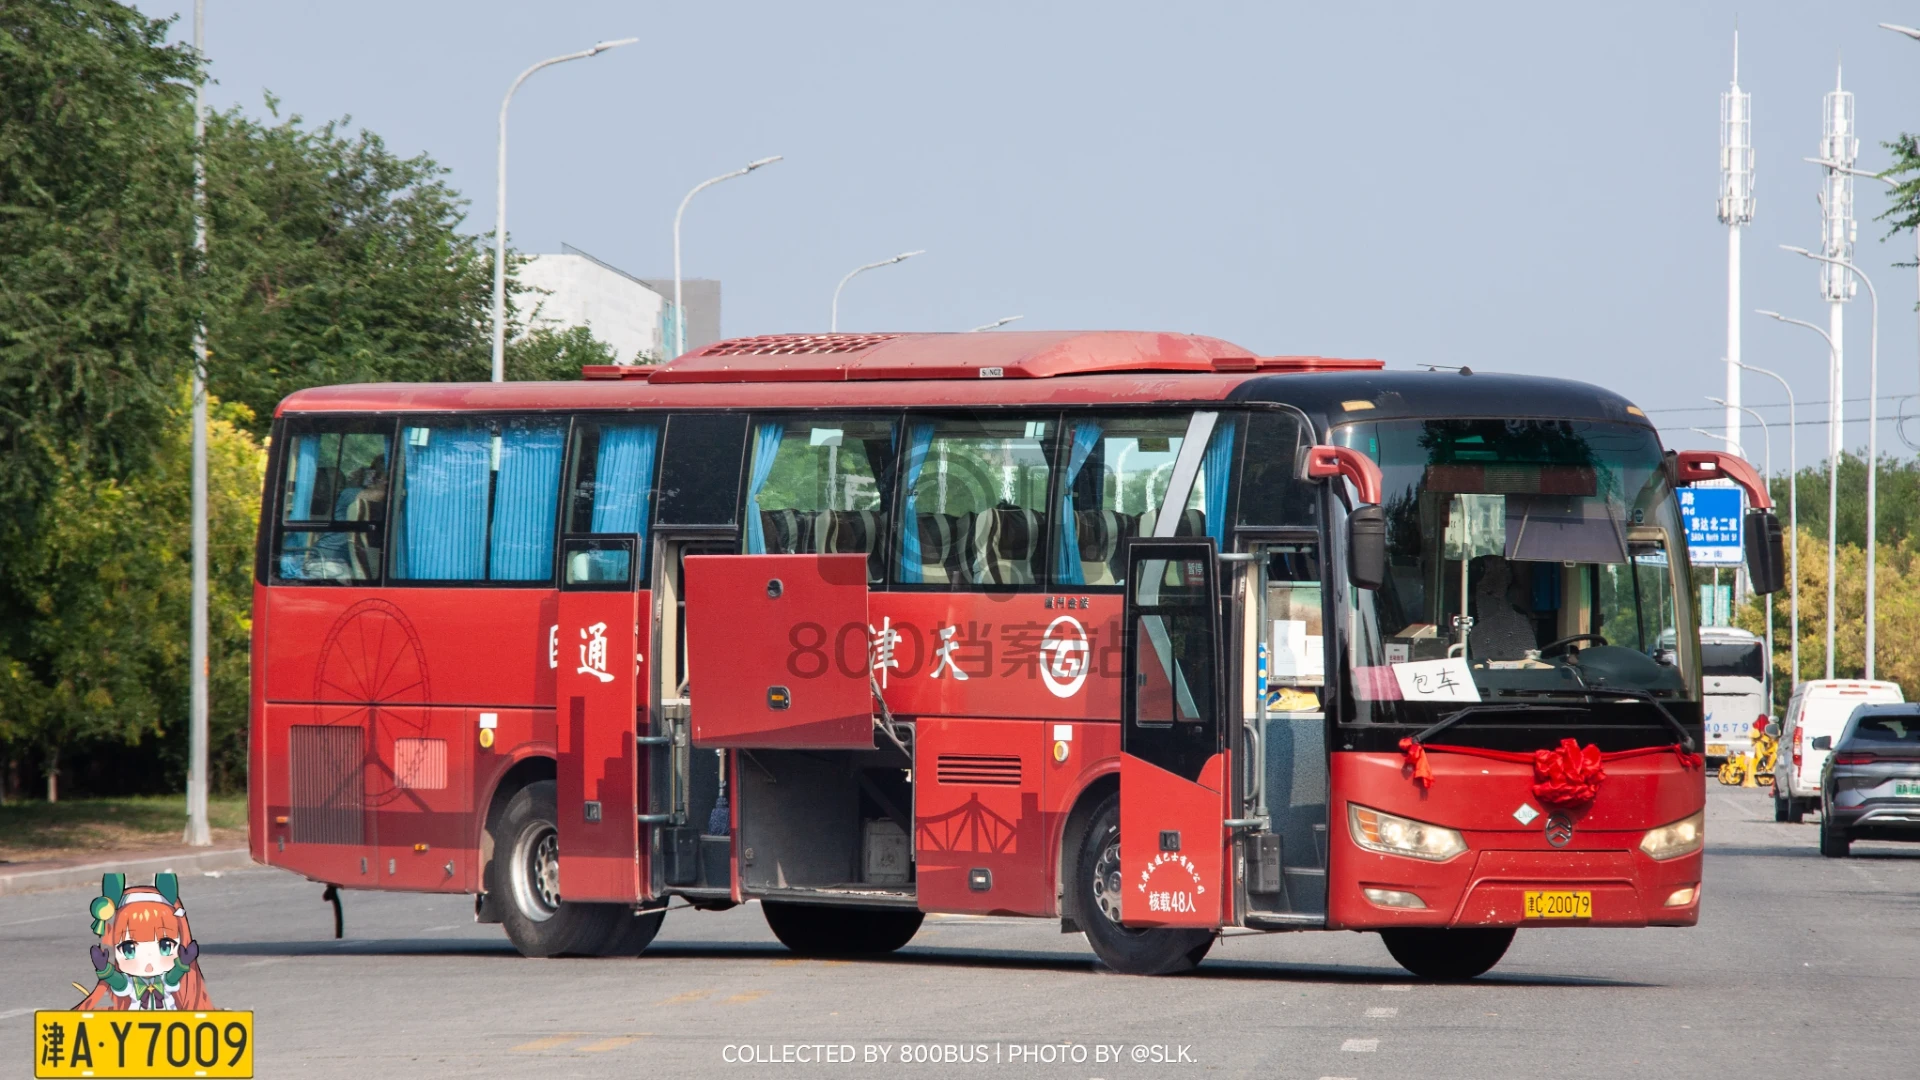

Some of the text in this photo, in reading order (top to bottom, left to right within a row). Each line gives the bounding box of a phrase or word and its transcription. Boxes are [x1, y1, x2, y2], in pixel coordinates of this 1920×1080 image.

[577, 622, 615, 682] 通
[1412, 667, 1460, 695] 包车
[1149, 891, 1196, 912] 核载48人
